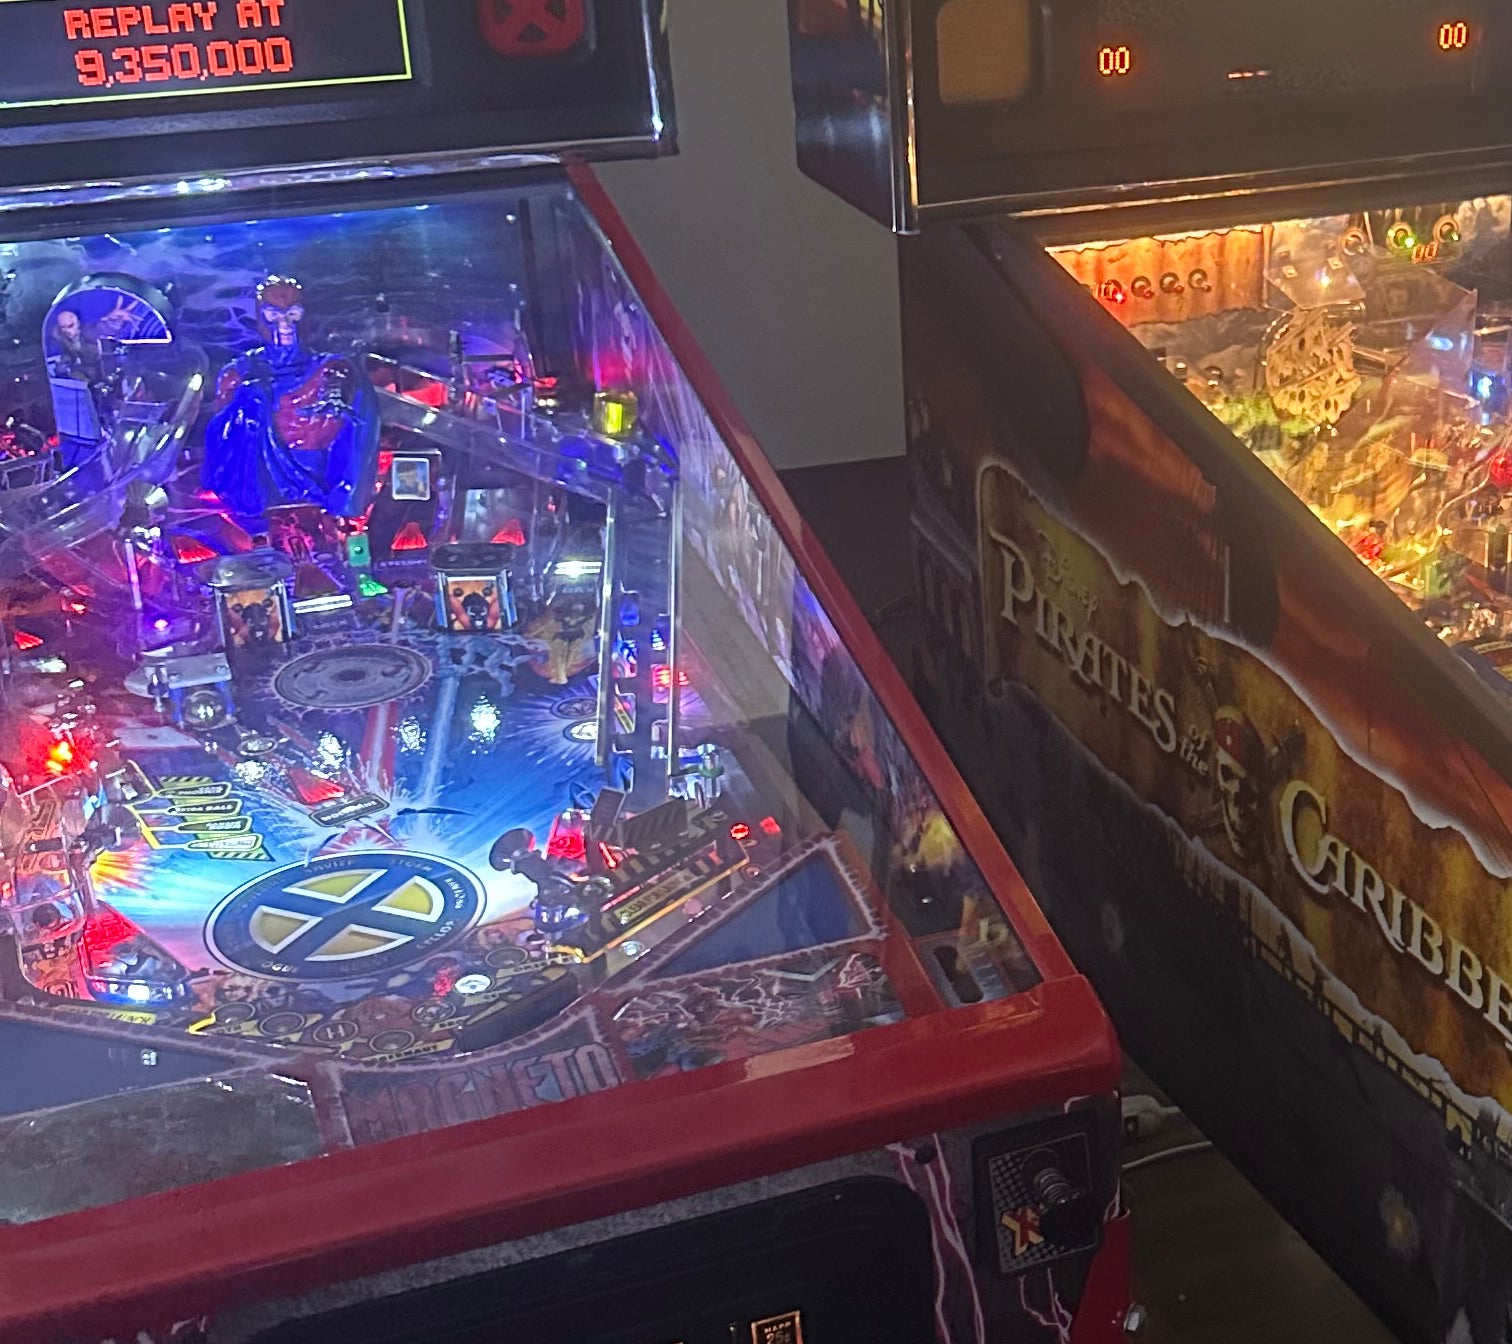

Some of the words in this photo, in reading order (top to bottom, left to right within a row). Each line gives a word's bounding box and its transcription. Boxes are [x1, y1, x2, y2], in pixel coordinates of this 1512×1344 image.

[64, 1, 217, 40] REPLAY
[1439, 21, 1468, 50] 00
[74, 37, 293, 88] 9,350,000
[1099, 46, 1131, 75] 00
[989, 527, 1179, 753] PIRATES
